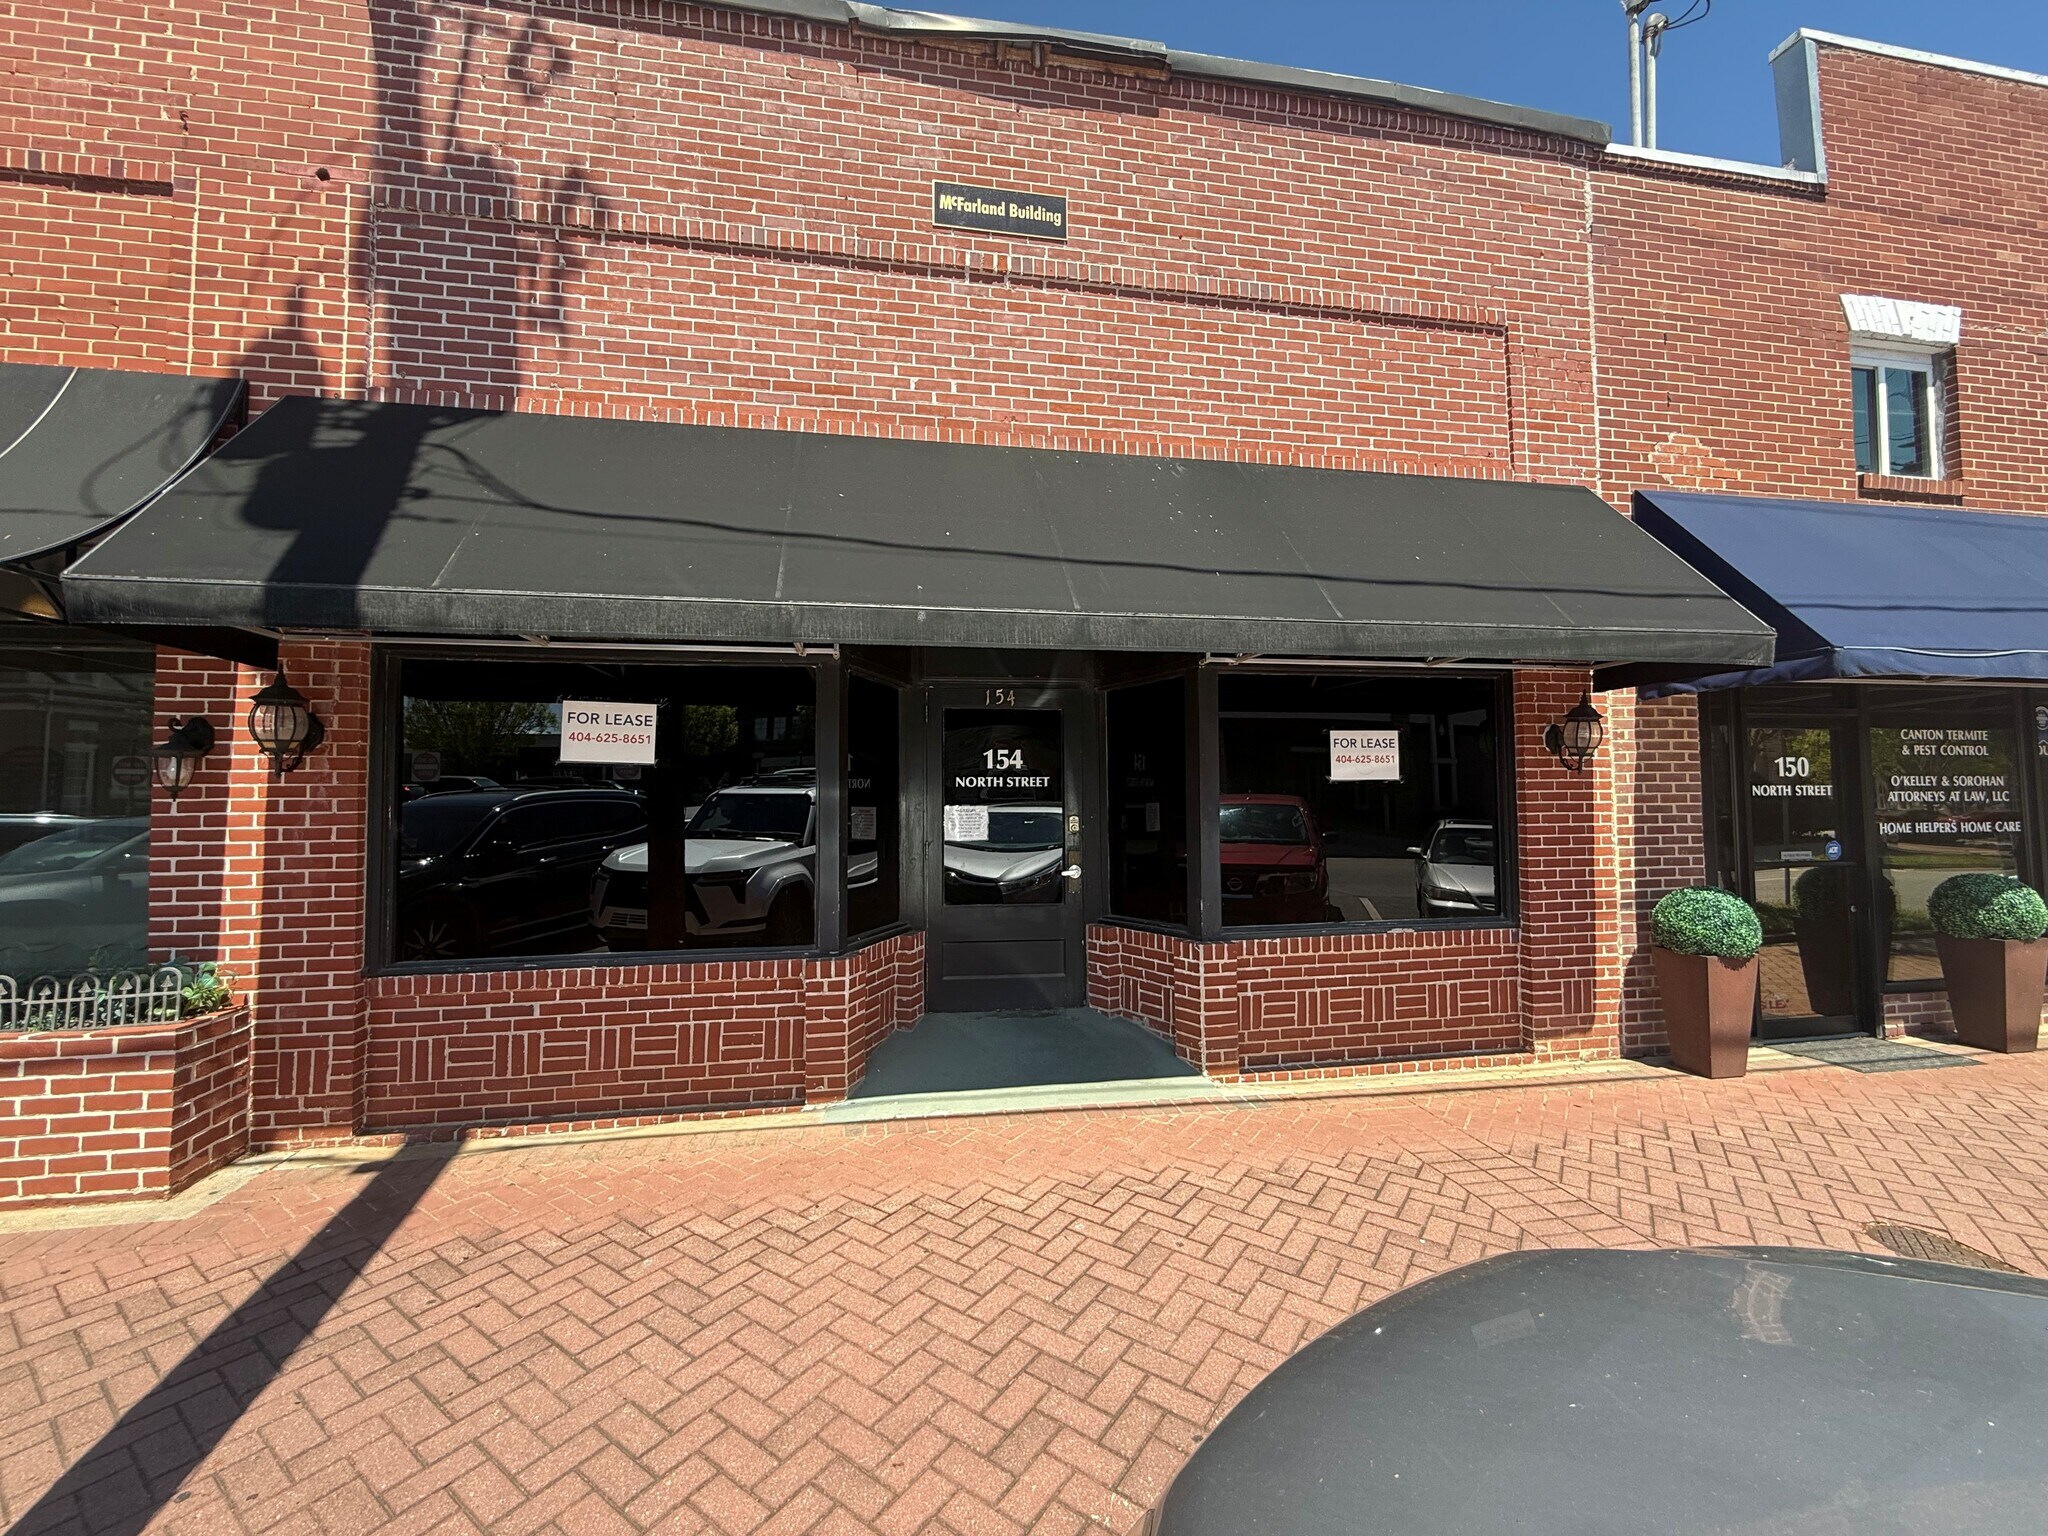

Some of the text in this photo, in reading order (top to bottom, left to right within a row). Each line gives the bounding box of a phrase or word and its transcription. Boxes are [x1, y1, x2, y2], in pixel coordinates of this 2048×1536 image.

[939, 194, 1062, 227] McFarland Building
[984, 688, 1016, 707] 154
[567, 711, 653, 727] FOR LEASE
[568, 731, 651, 745] 404-625-8651
[1900, 728, 1989, 741] CANTON TERMITE
[1333, 737, 1396, 749] FOR LEASE
[1901, 744, 1989, 756] & PEST CONTROL
[983, 748, 1024, 770] 154
[1335, 754, 1395, 764] 404-625-8651
[1774, 756, 1810, 778] 150
[955, 776, 1050, 788] NORTH STREET
[1890, 775, 2005, 787] O'KELLEY & SOROHAN
[1752, 784, 1833, 797] NORTH STREET
[1887, 790, 2010, 803] ATTORNEYS AT LAW, LLC
[1879, 821, 2022, 835] HOME HELPERS HOME CARE
